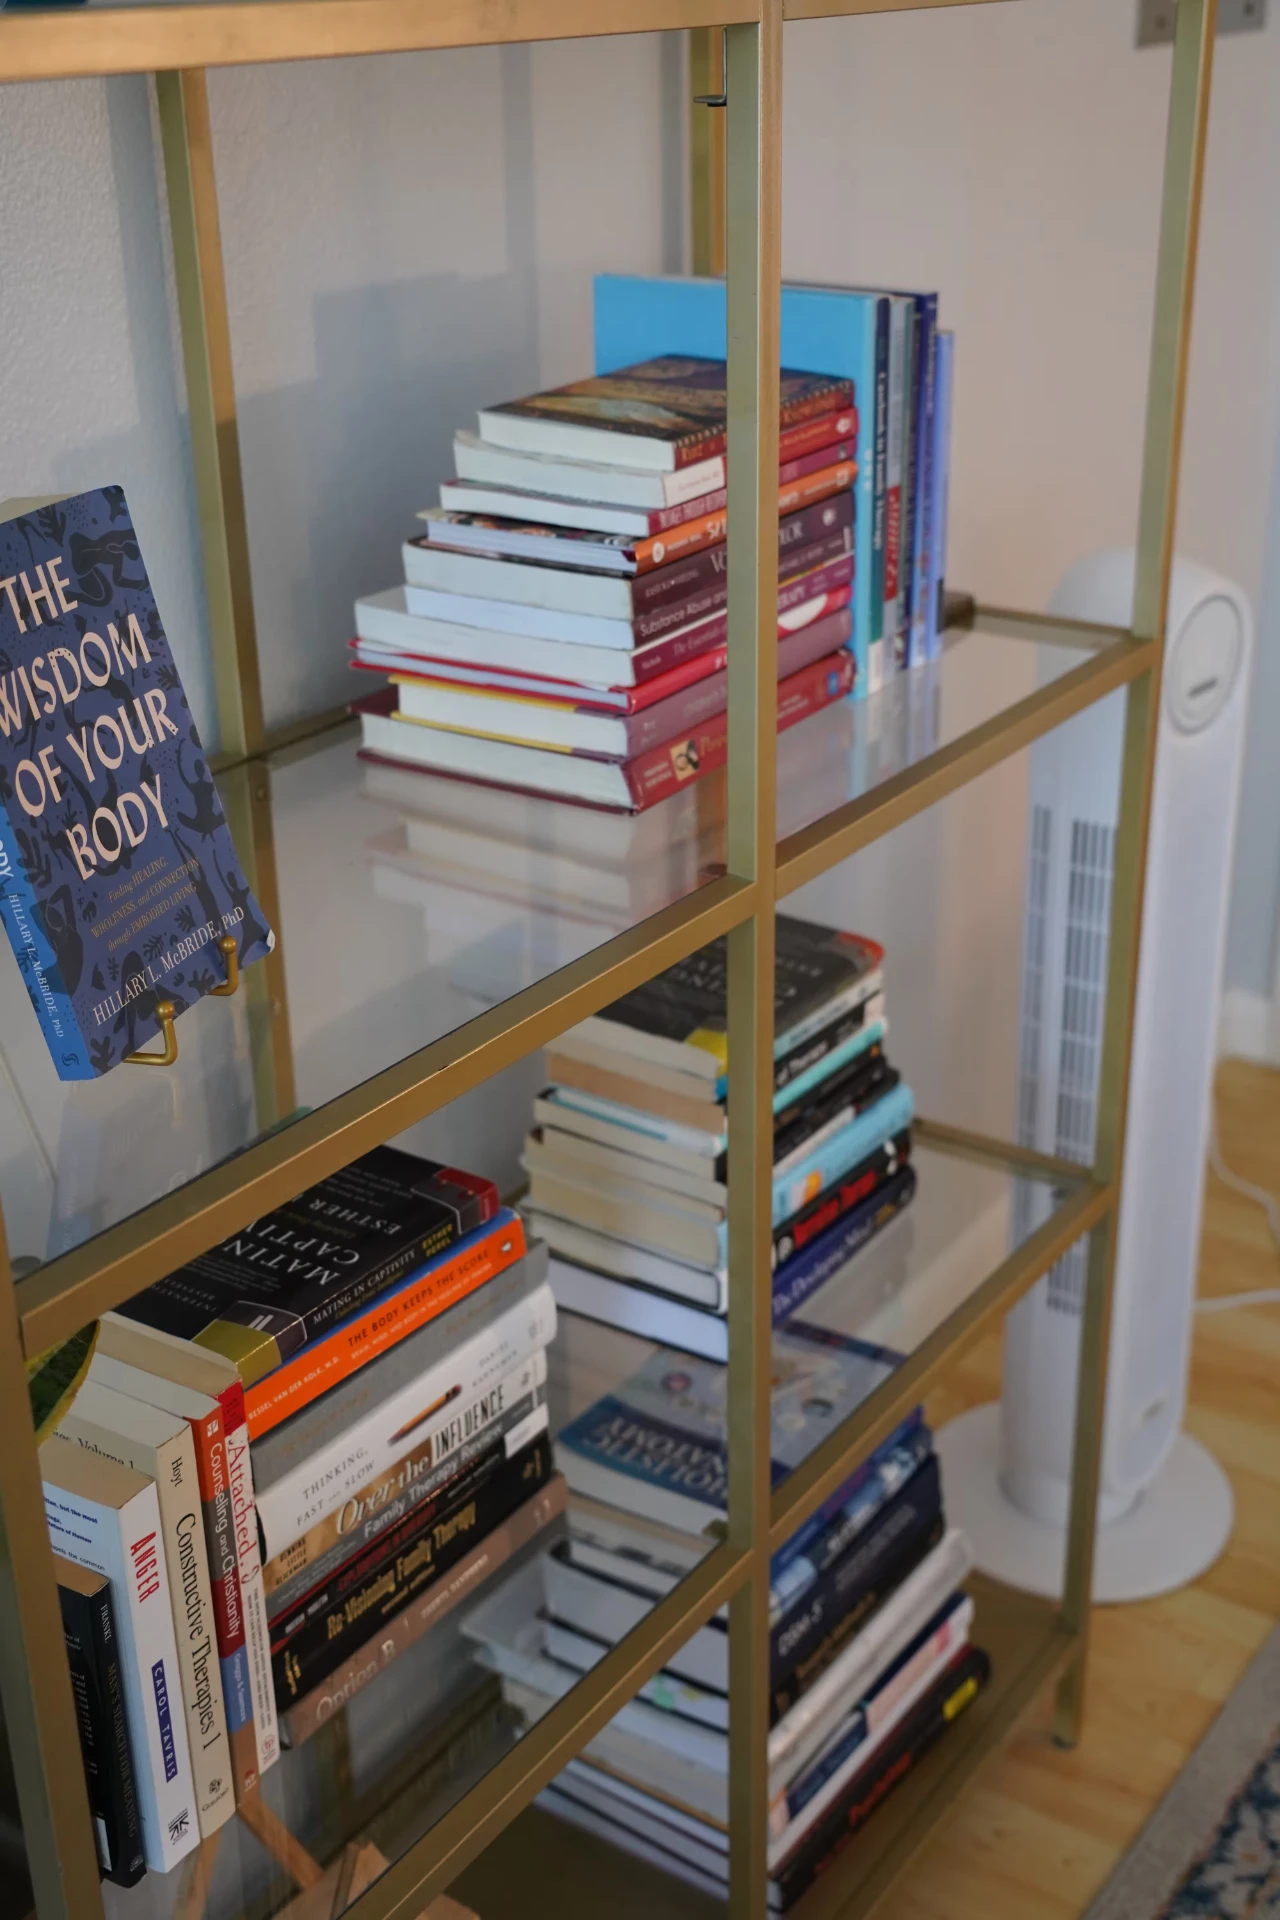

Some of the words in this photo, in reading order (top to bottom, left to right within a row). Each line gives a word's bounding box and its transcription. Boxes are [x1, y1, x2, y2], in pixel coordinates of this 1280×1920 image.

[0, 556, 78, 633] THE
[0, 613, 152, 737] WISDOM
[15, 744, 62, 817] OF
[66, 688, 179, 783] YOUR
[66, 775, 169, 881] BODY
[108, 881, 134, 903] Finding
[108, 928, 132, 951] through
[131, 901, 169, 933] EMBODIED
[171, 881, 197, 906] LIVING
[137, 892, 150, 907] and
[149, 858, 200, 898] CONNECTION
[8, 893, 31, 946] HILLARY
[27, 944, 37, 961] L.
[33, 961, 54, 1016] McBRIDE,
[52, 1018, 64, 1038] PhD
[92, 970, 148, 1026] HILLARY
[148, 966, 163, 984] L.
[160, 920, 222, 974] McBRIDE,
[221, 906, 245, 930] PhD
[309, 1198, 402, 1236] ESTHER
[222, 1238, 341, 1286] MATIN
[312, 1292, 352, 1325] MATING
[353, 1283, 366, 1298] IN
[367, 1248, 416, 1287] CAPTIVITY
[347, 1328, 369, 1348] THE
[371, 1309, 399, 1333] BODY
[402, 1284, 434, 1311] KEEPS
[436, 1273, 455, 1288] THE
[458, 1250, 489, 1275] SCORE
[247, 1400, 273, 1421] BESSEL
[273, 1390, 289, 1403] VAN
[289, 1379, 303, 1394] DER
[435, 1383, 504, 1460] INFLUENCE
[170, 1456, 184, 1487] Hoyt
[209, 1442, 228, 1534] Counseling
[227, 1444, 257, 1568] Attached.
[296, 1499, 325, 1527] FAST
[343, 1459, 375, 1489] SLOW
[302, 1447, 369, 1500] THINKING,
[336, 1478, 395, 1535] Over
[398, 1456, 430, 1489] the
[364, 1500, 406, 1538] Family
[408, 1457, 460, 1501] Therapy
[130, 1530, 161, 1604] ANGER
[176, 1512, 207, 1641] Constructive
[219, 1534, 228, 1557] and
[326, 1568, 396, 1640] Re-Visioning
[396, 1538, 432, 1581] Family
[432, 1501, 476, 1550] Therapy
[100, 1603, 113, 1644] FRANKL
[221, 1555, 240, 1640] Christianity
[107, 1661, 119, 1706] MAN'S
[191, 1635, 218, 1735] Therapies
[316, 1660, 379, 1723] Option
[381, 1639, 396, 1663] B
[112, 1704, 128, 1753] SEARCH
[154, 1666, 168, 1717] CAROL
[162, 1723, 176, 1778] TAVRIS
[203, 1732, 222, 1751] 1
[119, 1752, 131, 1775] FOR
[122, 1774, 139, 1839] MEANING
